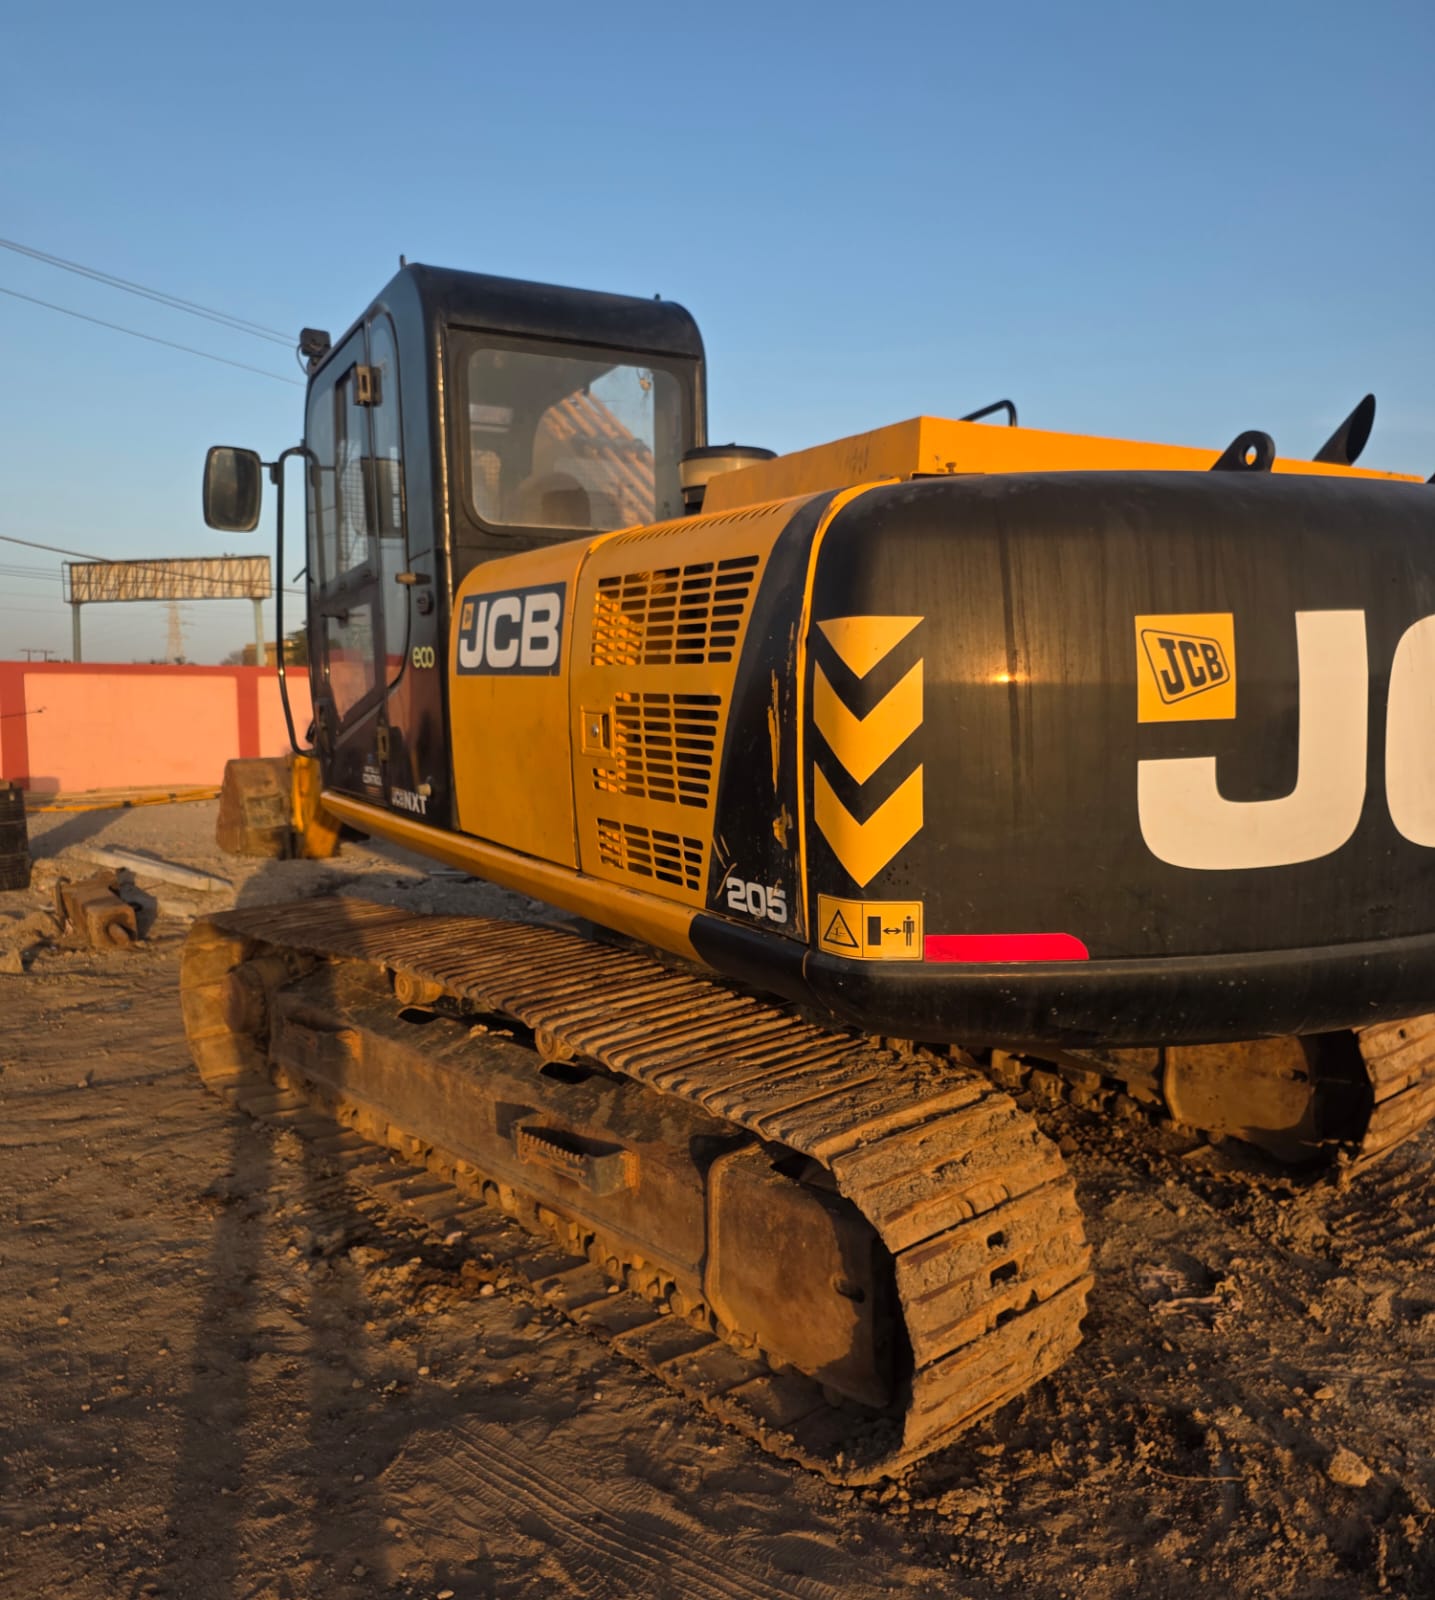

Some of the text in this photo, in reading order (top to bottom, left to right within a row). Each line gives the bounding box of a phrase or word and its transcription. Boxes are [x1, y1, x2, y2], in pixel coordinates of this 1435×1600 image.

[460, 592, 561, 668] JCB
[1158, 638, 1224, 695] JCB
[1137, 609, 1435, 870] J
[726, 877, 788, 924] 205
